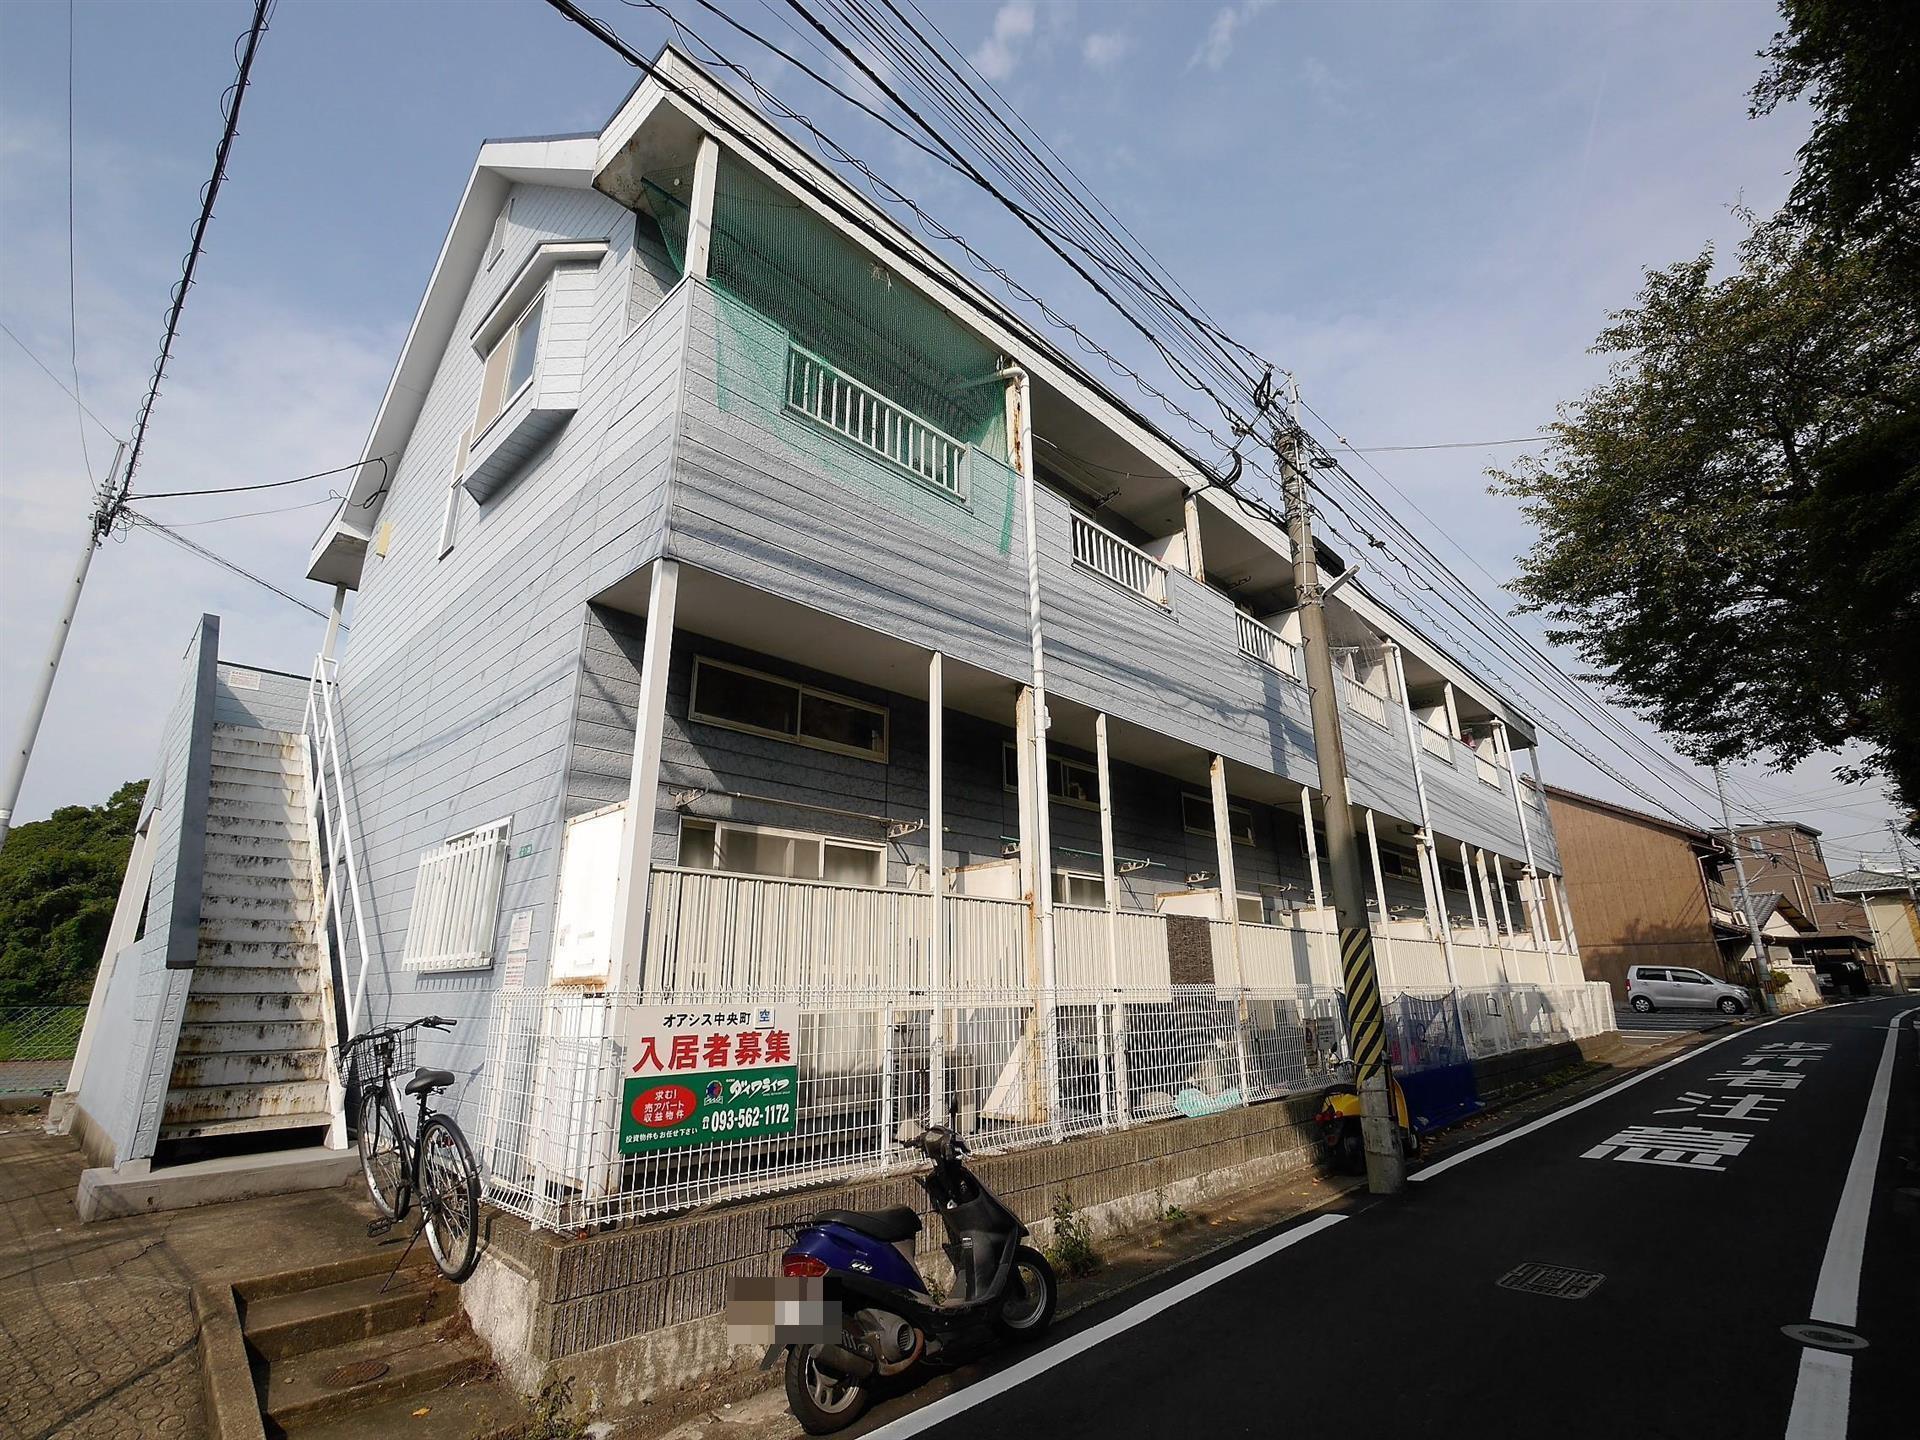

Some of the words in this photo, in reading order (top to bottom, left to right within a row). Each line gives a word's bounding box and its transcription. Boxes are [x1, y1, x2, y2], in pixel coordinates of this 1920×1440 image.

[663, 1012, 751, 1028] オアシス中央町
[759, 1008, 771, 1023] 空
[632, 1030, 791, 1073] 入居者募集
[644, 1100, 684, 1113] 売アパート
[643, 1110, 684, 1123] 収益物件
[711, 1103, 790, 1132] 093-562-1172
[625, 1127, 698, 1144] 投資物件もお任せ下さい
